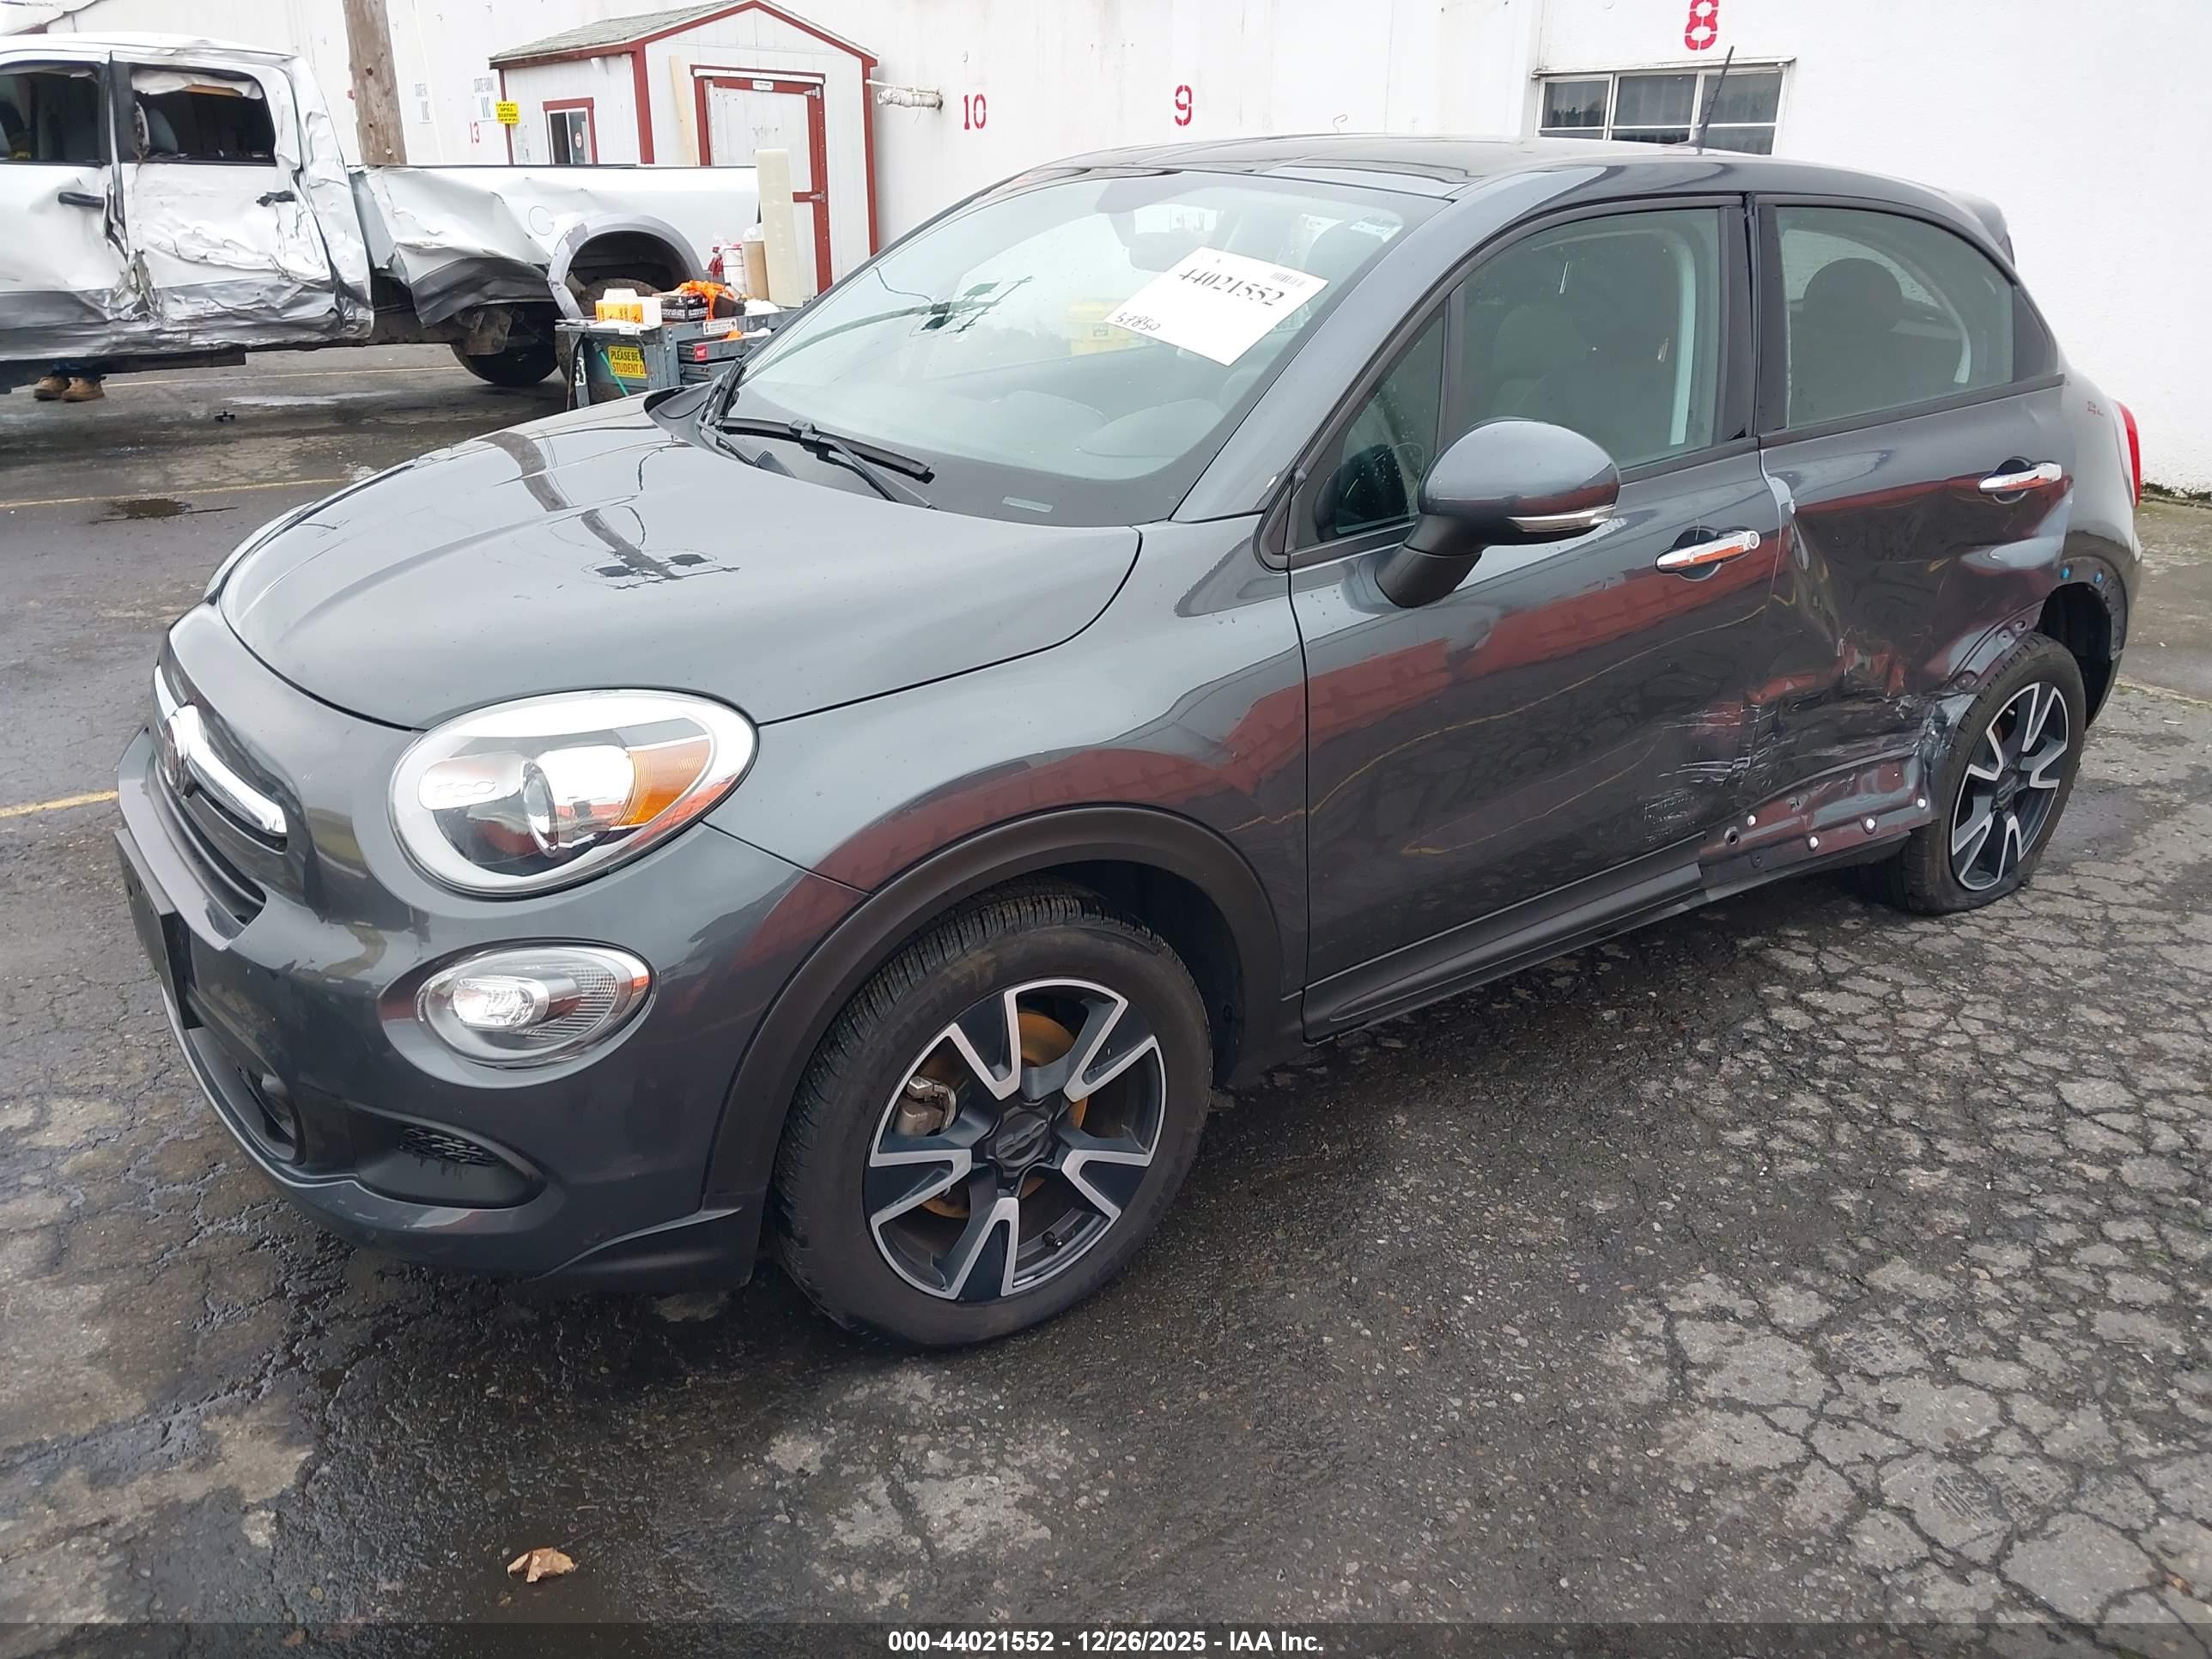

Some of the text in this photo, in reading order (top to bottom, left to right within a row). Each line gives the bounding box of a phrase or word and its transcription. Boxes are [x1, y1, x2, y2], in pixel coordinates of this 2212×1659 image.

[1685, 0, 1718, 50] 8
[963, 94, 987, 130] 10
[1175, 84, 1193, 127] 9
[470, 121, 480, 144] 13
[1179, 267, 1285, 307] 44021552
[611, 349, 630, 362] PLEASE
[631, 351, 639, 362] BE
[612, 362, 638, 374] STUDENT
